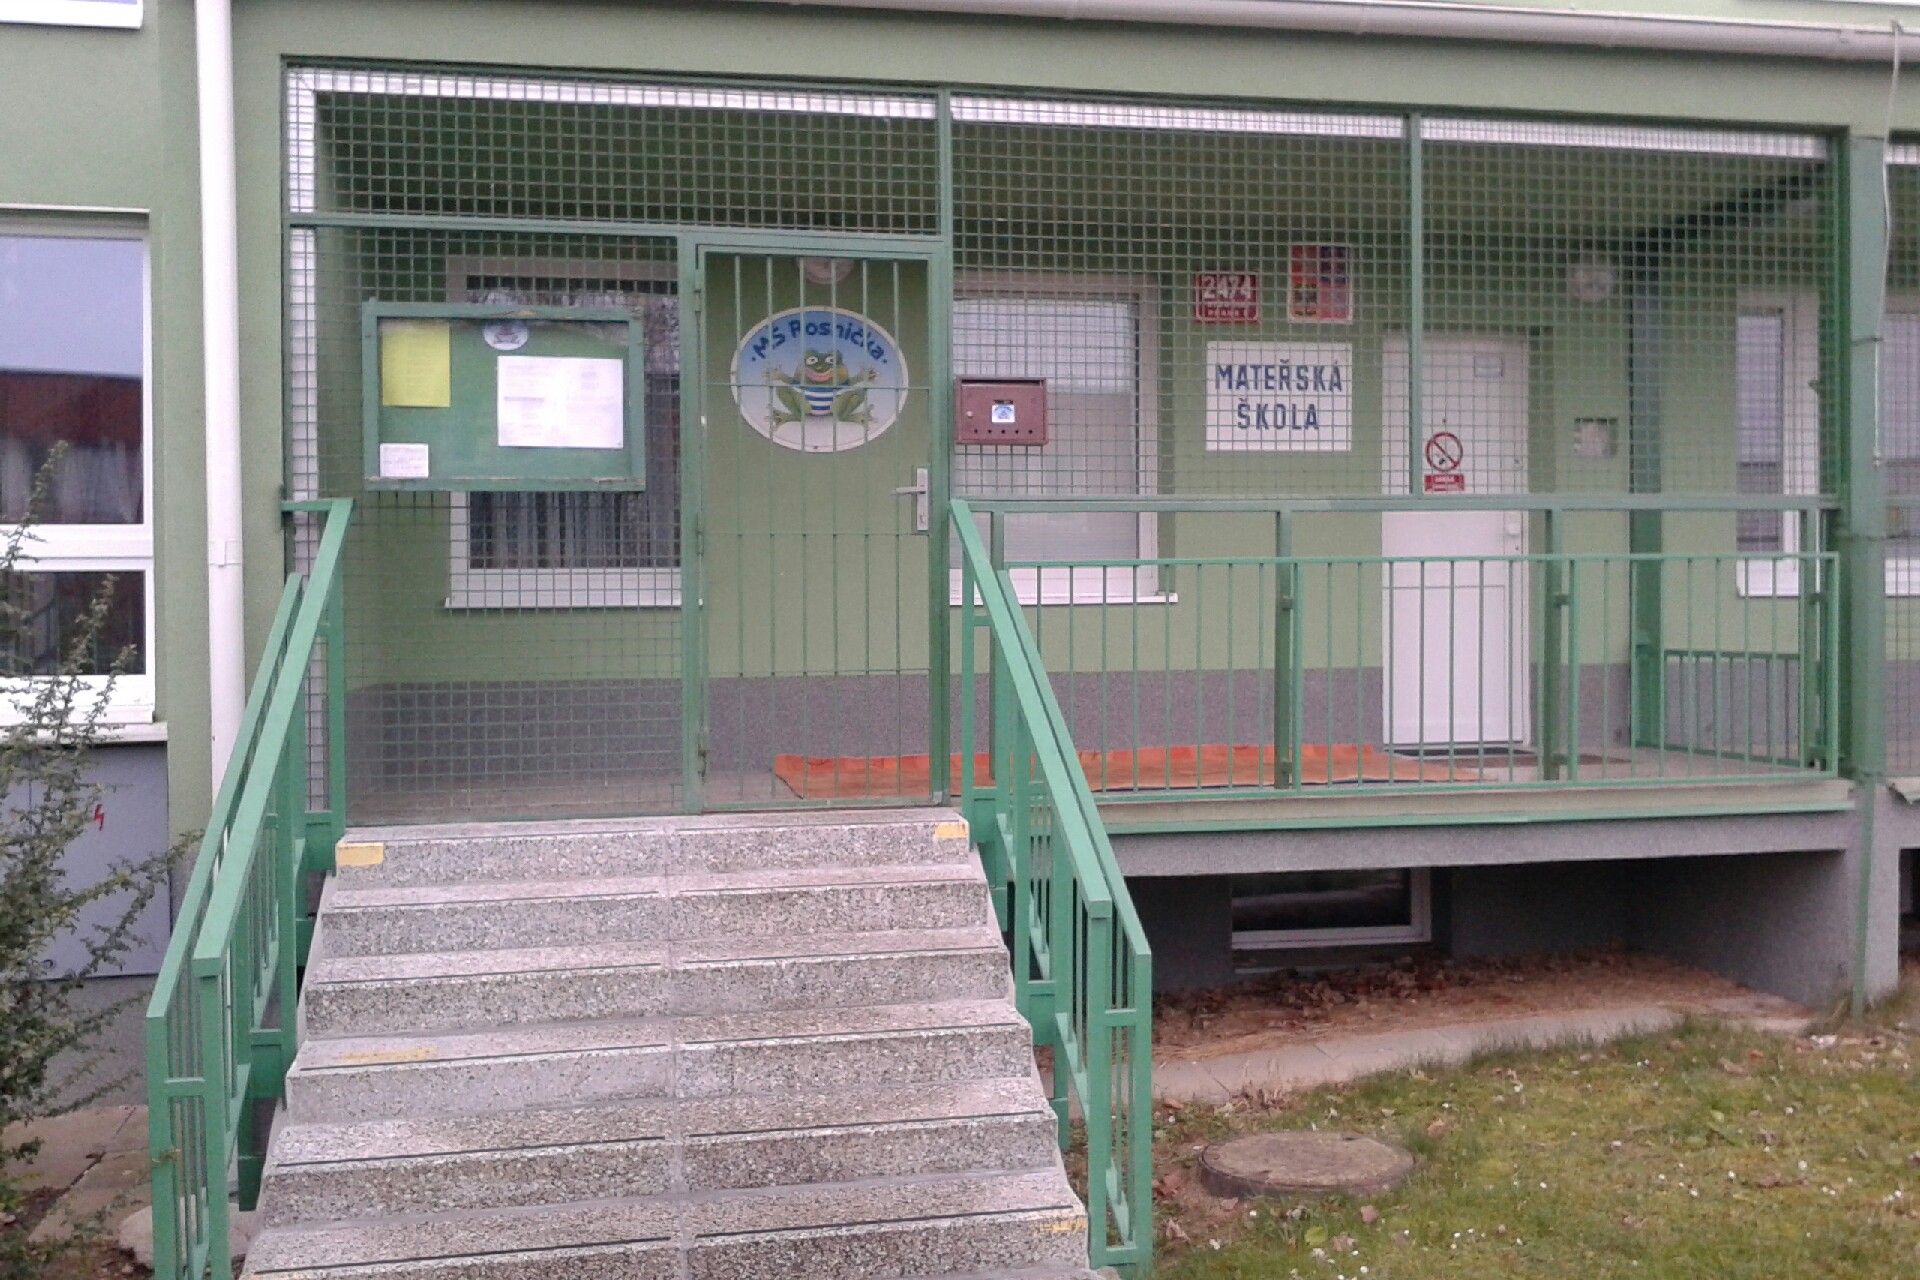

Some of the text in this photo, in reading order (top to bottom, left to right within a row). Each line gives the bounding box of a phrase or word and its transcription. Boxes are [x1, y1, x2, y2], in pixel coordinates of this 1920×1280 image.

[1202, 275, 1251, 300] 2474
[1215, 358, 1343, 392] MATEŘSKÁ
[1237, 397, 1320, 431] ŠKOLA
